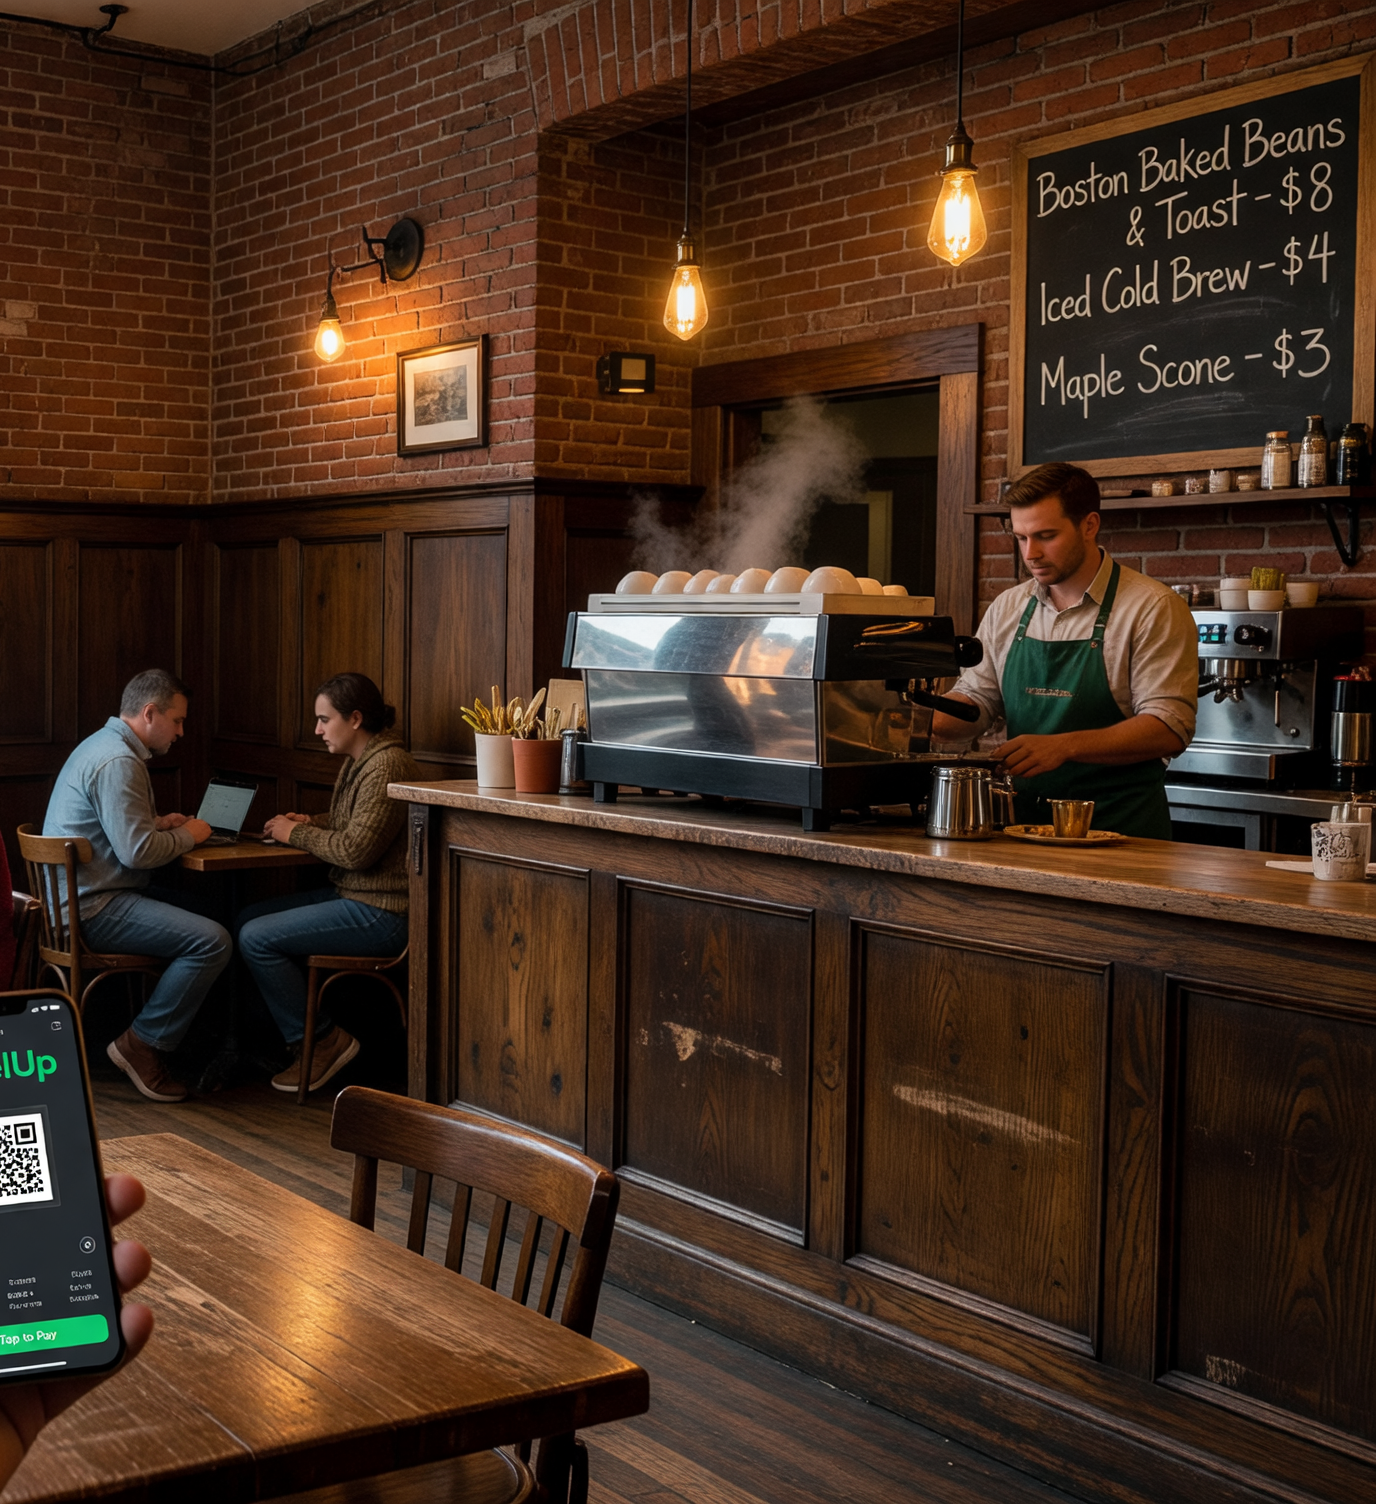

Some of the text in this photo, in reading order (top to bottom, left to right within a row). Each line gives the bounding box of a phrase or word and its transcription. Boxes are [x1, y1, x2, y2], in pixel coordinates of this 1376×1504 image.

[1036, 117, 1346, 217] Boston Baked Beans
[1126, 206, 1145, 247] &
[1155, 179, 1247, 239] Toast
[1279, 162, 1333, 215] $8
[1040, 274, 1091, 325] Iced
[1101, 259, 1160, 314] Cold
[1170, 255, 1252, 303] Brew
[1282, 231, 1336, 286] $4
[1040, 353, 1125, 419] Maple
[1137, 344, 1235, 394] Scone
[1272, 327, 1331, 379] $3
[0, 1330, 57, 1346] Tap to Pay
